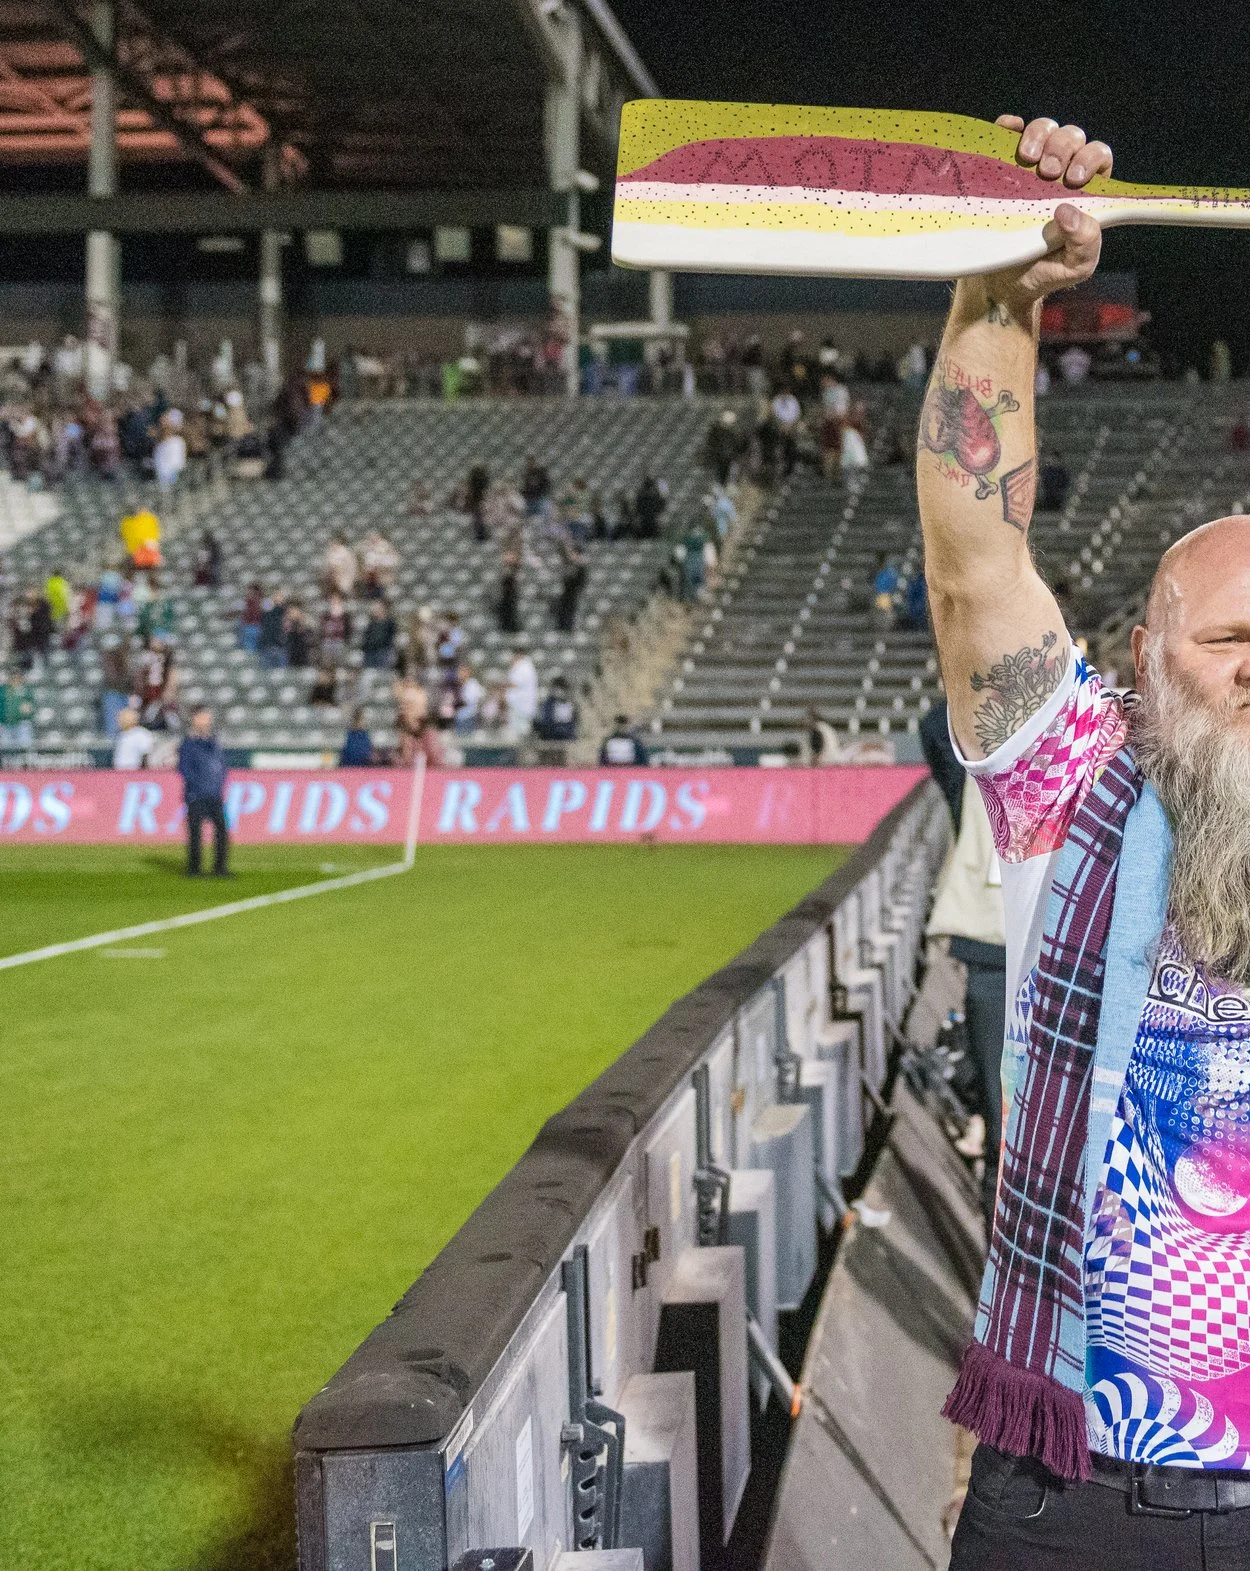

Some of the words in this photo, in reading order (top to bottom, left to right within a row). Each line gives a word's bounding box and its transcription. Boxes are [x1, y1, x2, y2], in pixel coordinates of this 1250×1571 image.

[697, 147, 968, 197] MOTM
[117, 780, 392, 834] RPIDS
[438, 780, 710, 833] RAPIDS
